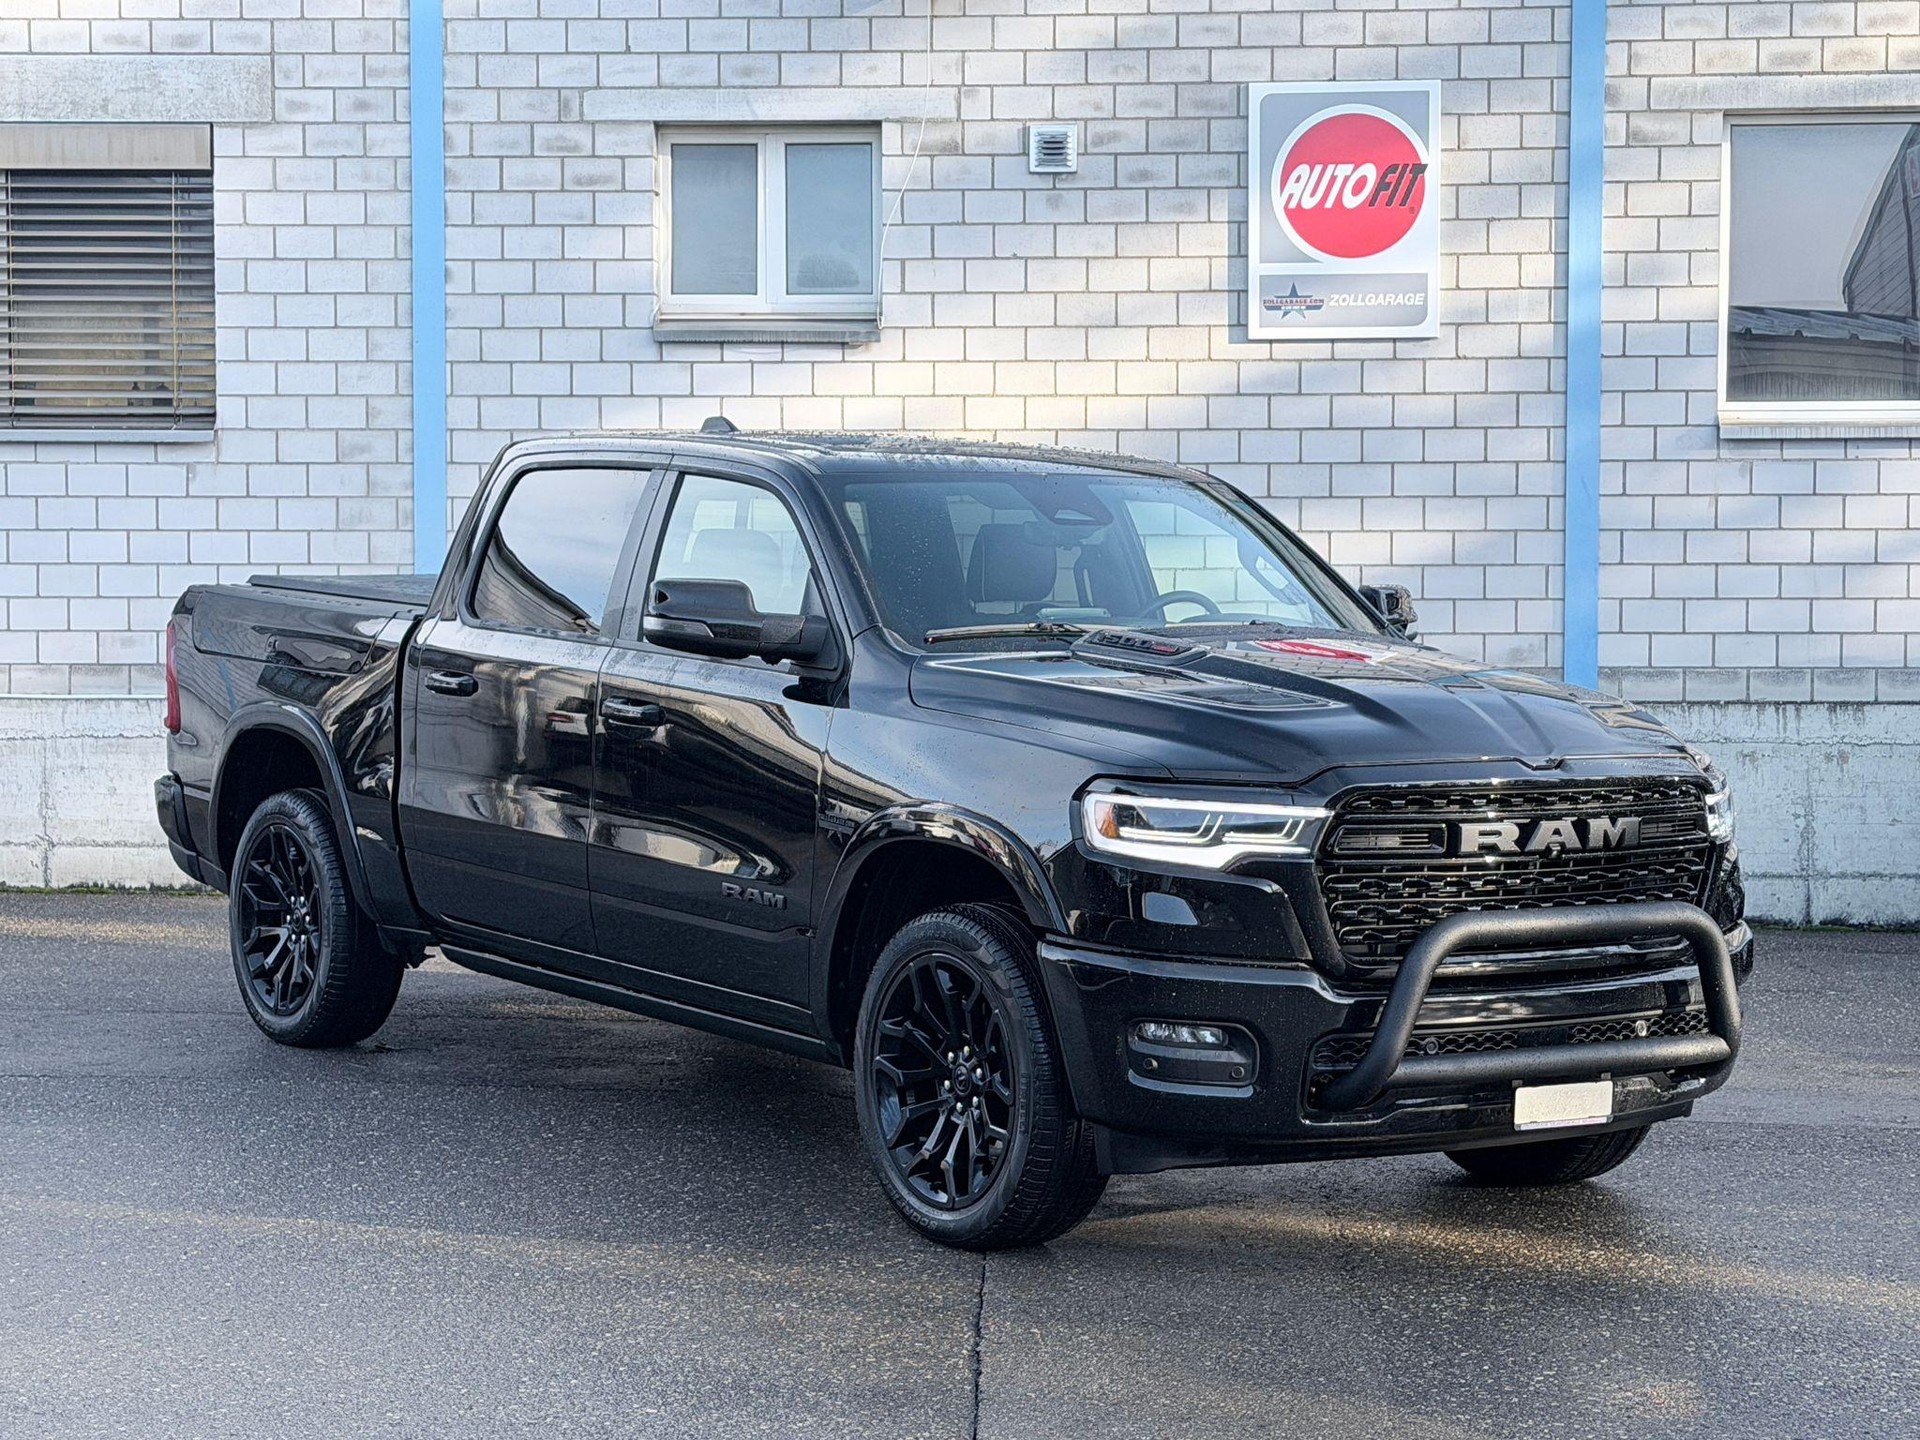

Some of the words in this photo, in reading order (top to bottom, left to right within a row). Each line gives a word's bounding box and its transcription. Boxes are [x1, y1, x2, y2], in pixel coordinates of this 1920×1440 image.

[1281, 163, 1428, 209] AUTOFIT
[1329, 294, 1424, 307] ZOLLGARAGE
[1459, 816, 1640, 853] RAM
[721, 882, 785, 909] RAM
